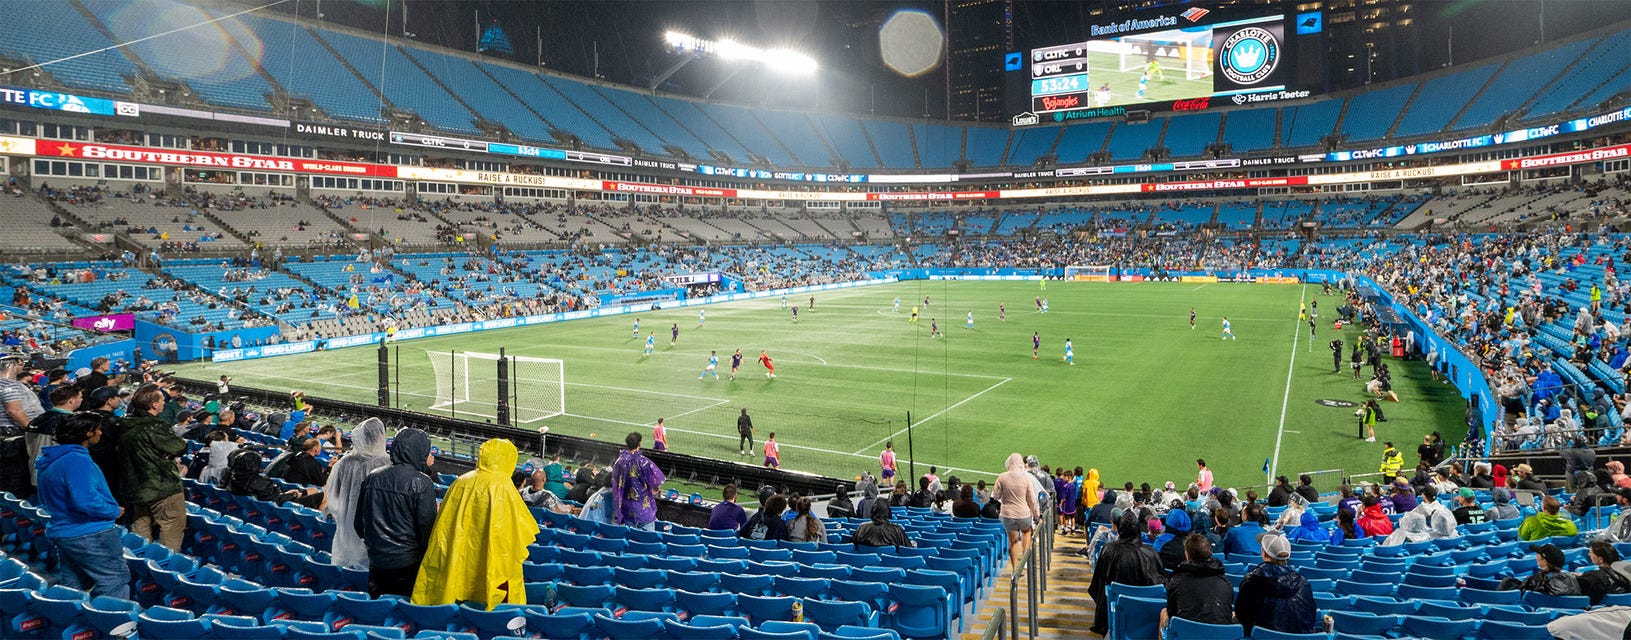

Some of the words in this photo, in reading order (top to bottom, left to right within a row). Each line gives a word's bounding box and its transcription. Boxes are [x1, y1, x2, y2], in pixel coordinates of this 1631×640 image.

[1091, 22, 1118, 36] Bank
[1118, 19, 1131, 32] of
[1131, 15, 1177, 31] America
[1226, 29, 1271, 49] CHARLOTTE
[1044, 49, 1069, 60] CLTFC
[1075, 47, 1082, 56] 0
[1044, 65, 1062, 74] ORL
[1075, 61, 1082, 70] 0
[1256, 63, 1271, 79] CLUB
[1226, 67, 1256, 82] FOOTBALL
[1041, 77, 1079, 92] 53:24
[0, 88, 25, 104] TE
[29, 92, 53, 108] FC
[1247, 93, 1278, 102] Harris
[1279, 89, 1310, 100] Teeter
[1042, 95, 1078, 111] Bojangles
[1066, 110, 1096, 120] Atrium
[1097, 106, 1126, 117] Health
[1588, 111, 1623, 127] CHARLOTTE
[297, 124, 347, 137] DAIMLER
[352, 129, 385, 141] TRUCK
[421, 137, 445, 147] CLTFC
[463, 141, 470, 149] 0
[1427, 138, 1472, 152] CHARLOTTE
[1472, 137, 1483, 146] FC
[82, 145, 229, 168] SOUTHERN
[232, 156, 295, 171] STAR
[1243, 158, 1272, 166] DAIMLER
[1274, 156, 1295, 164] TRUCK
[1520, 153, 1592, 168] SOUTHERN
[1592, 147, 1628, 160] STAR
[634, 160, 659, 168] DAIMLER
[660, 162, 676, 170] TRUCK
[478, 172, 502, 183] RAISE
[505, 175, 511, 183] A
[513, 176, 546, 185] RUCKUS!
[1370, 170, 1391, 180] RAISE
[1395, 170, 1400, 178] A
[1403, 168, 1435, 177] RUCKUS!
[617, 183, 669, 194] SOUTHERN
[669, 187, 693, 195] STAR
[1155, 181, 1213, 191] SOUTHERN
[1214, 180, 1245, 189] STAR
[93, 317, 116, 329] ally
